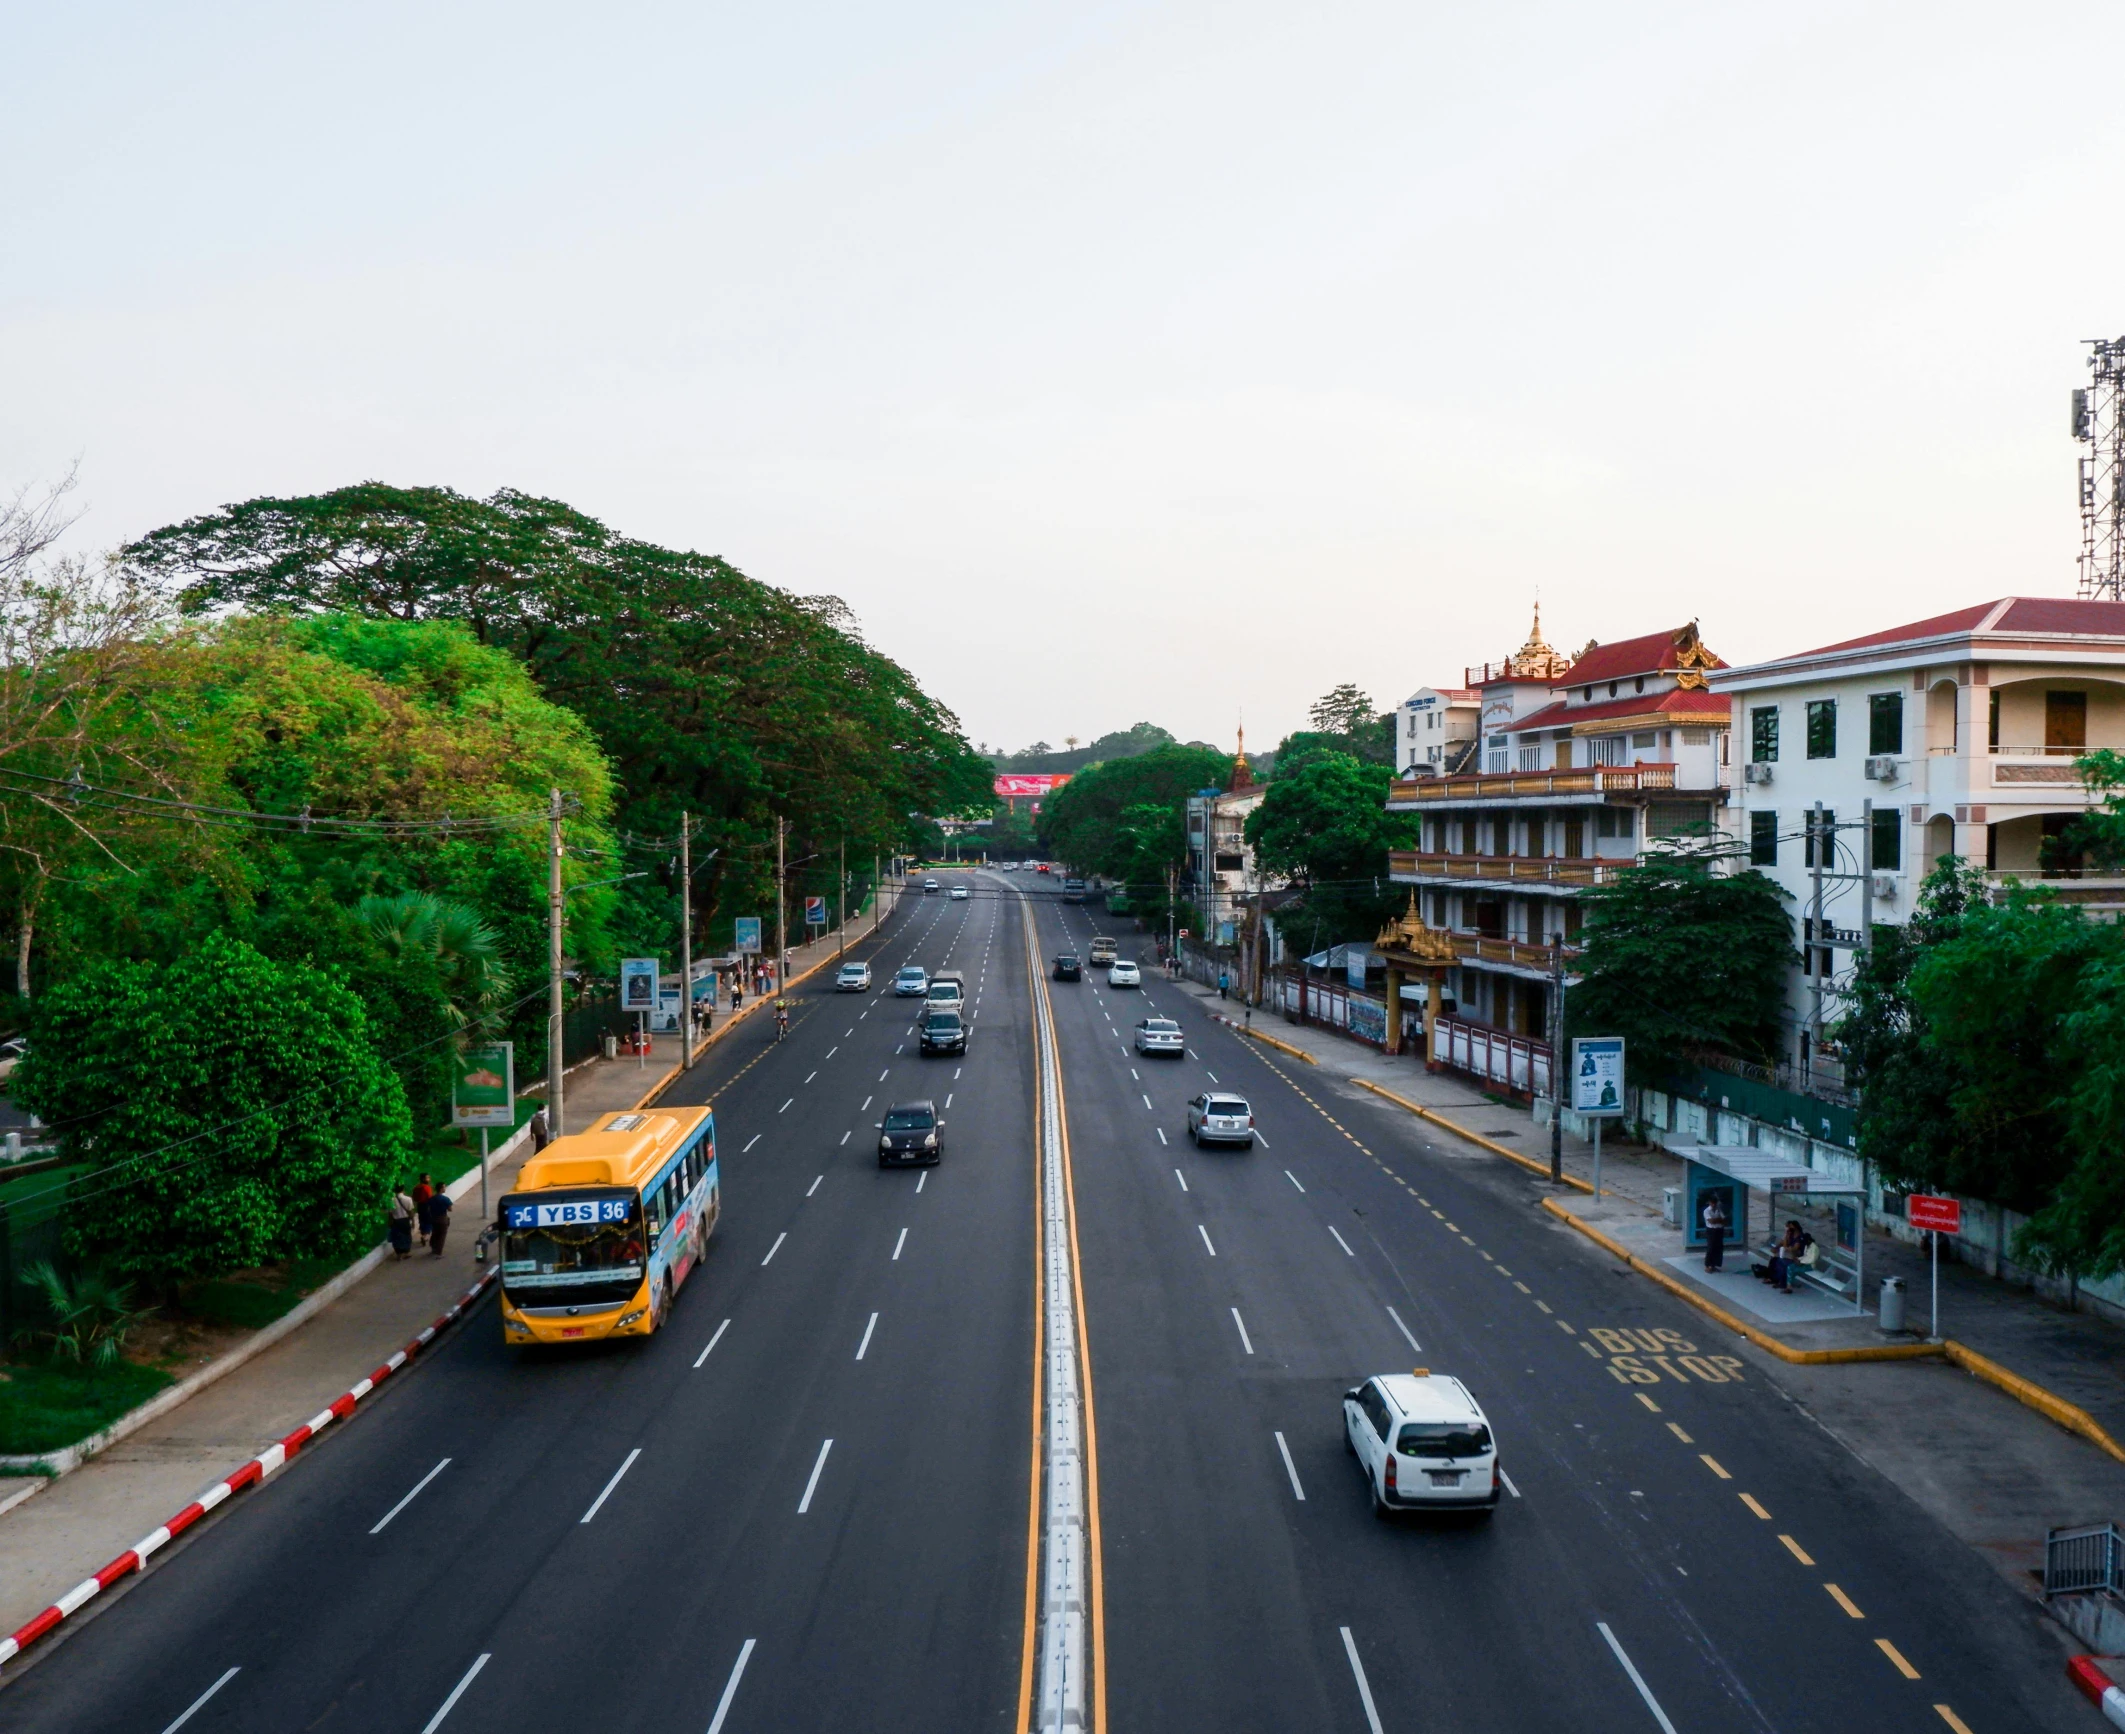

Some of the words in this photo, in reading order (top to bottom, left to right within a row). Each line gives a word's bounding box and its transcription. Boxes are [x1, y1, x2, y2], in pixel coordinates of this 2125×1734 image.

[545, 1205, 593, 1222] YBS
[603, 1202, 625, 1220] 36
[1588, 1328, 1698, 1353] BUS
[1610, 1355, 1746, 1384] STOP
